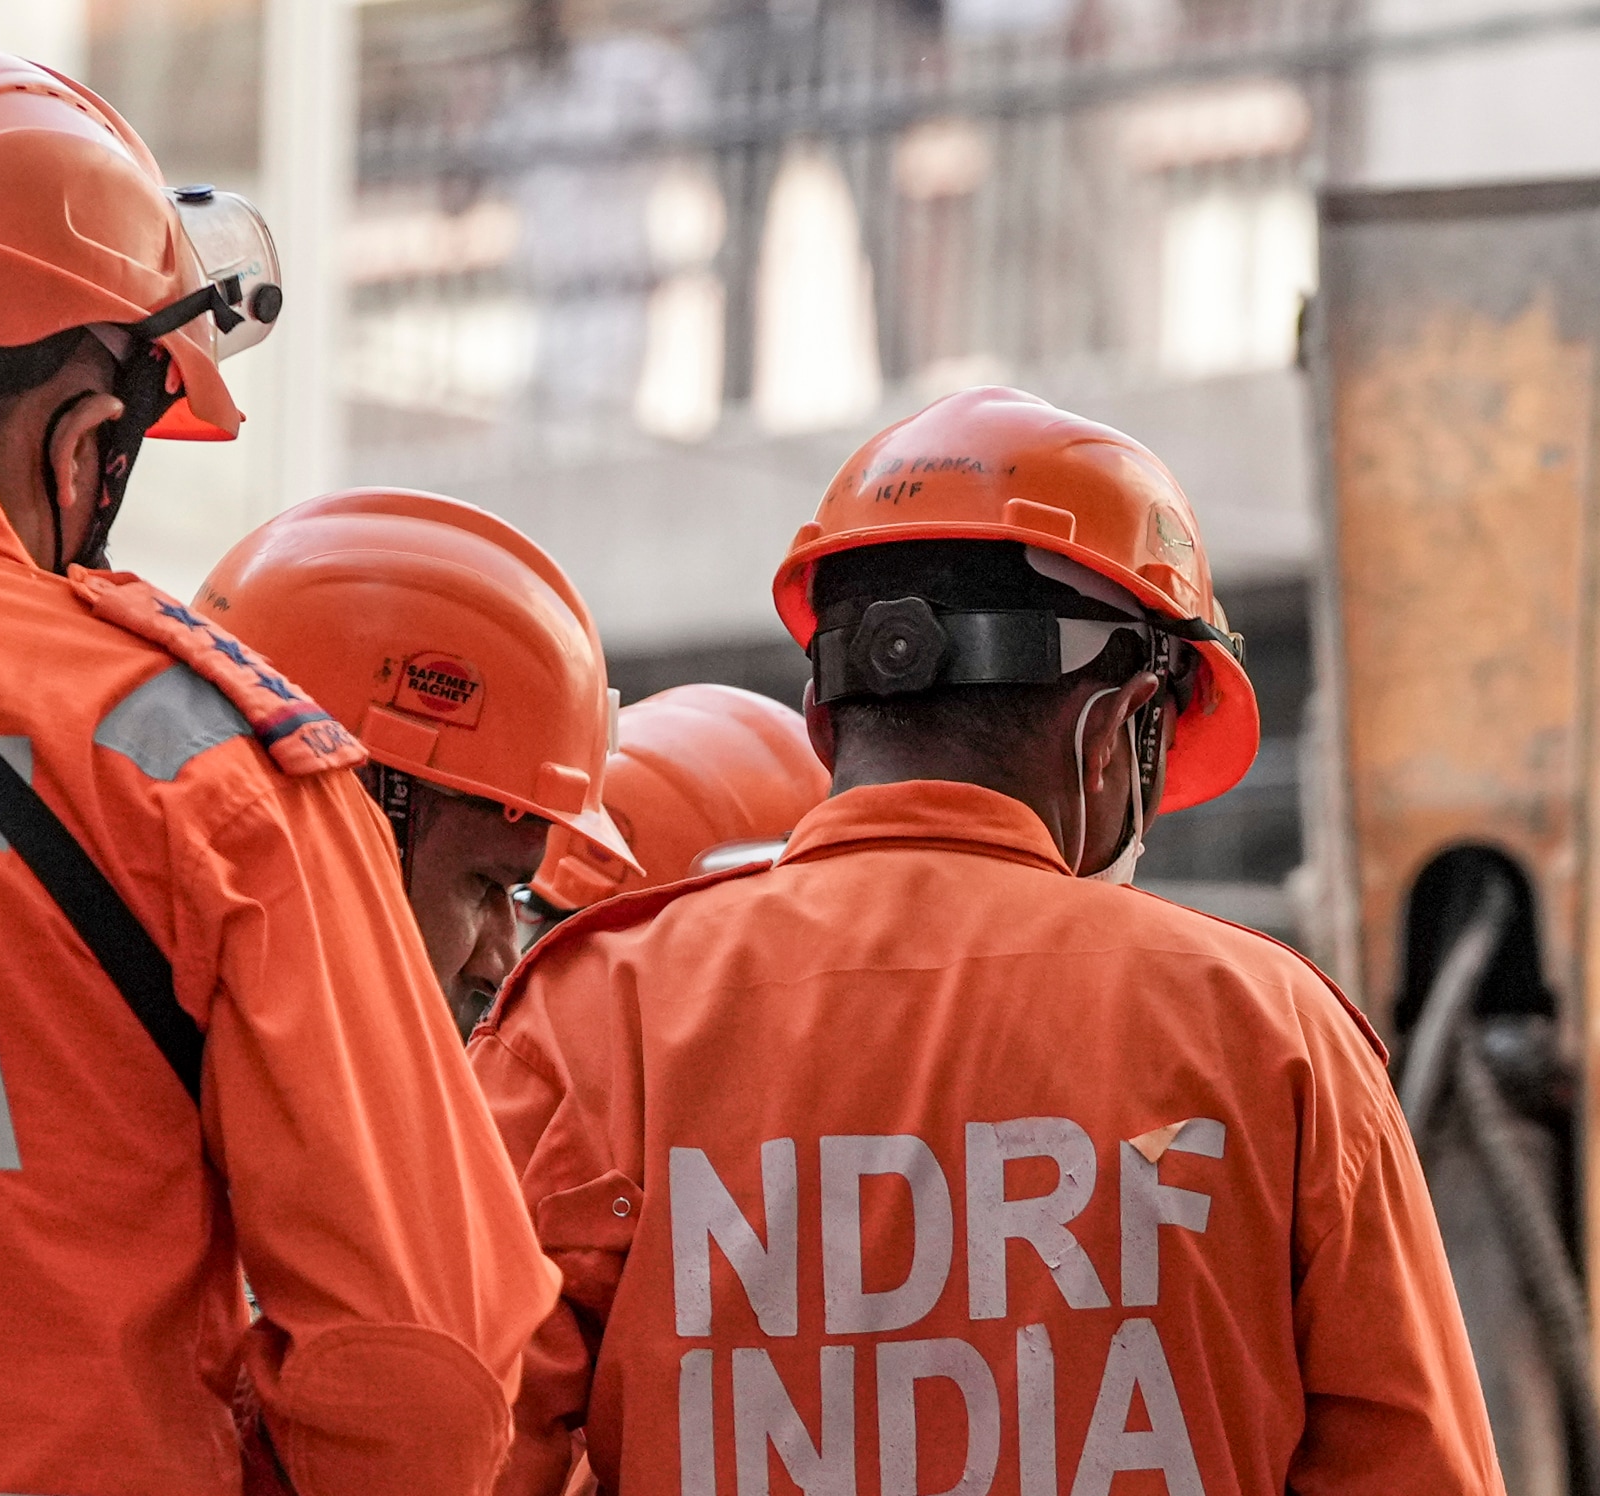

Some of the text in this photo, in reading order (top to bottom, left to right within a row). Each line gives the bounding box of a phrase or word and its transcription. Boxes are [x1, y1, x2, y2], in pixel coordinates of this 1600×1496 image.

[407, 664, 480, 694] SAFEMET
[408, 678, 471, 704] RACHET
[667, 1115, 1227, 1338] NDRF
